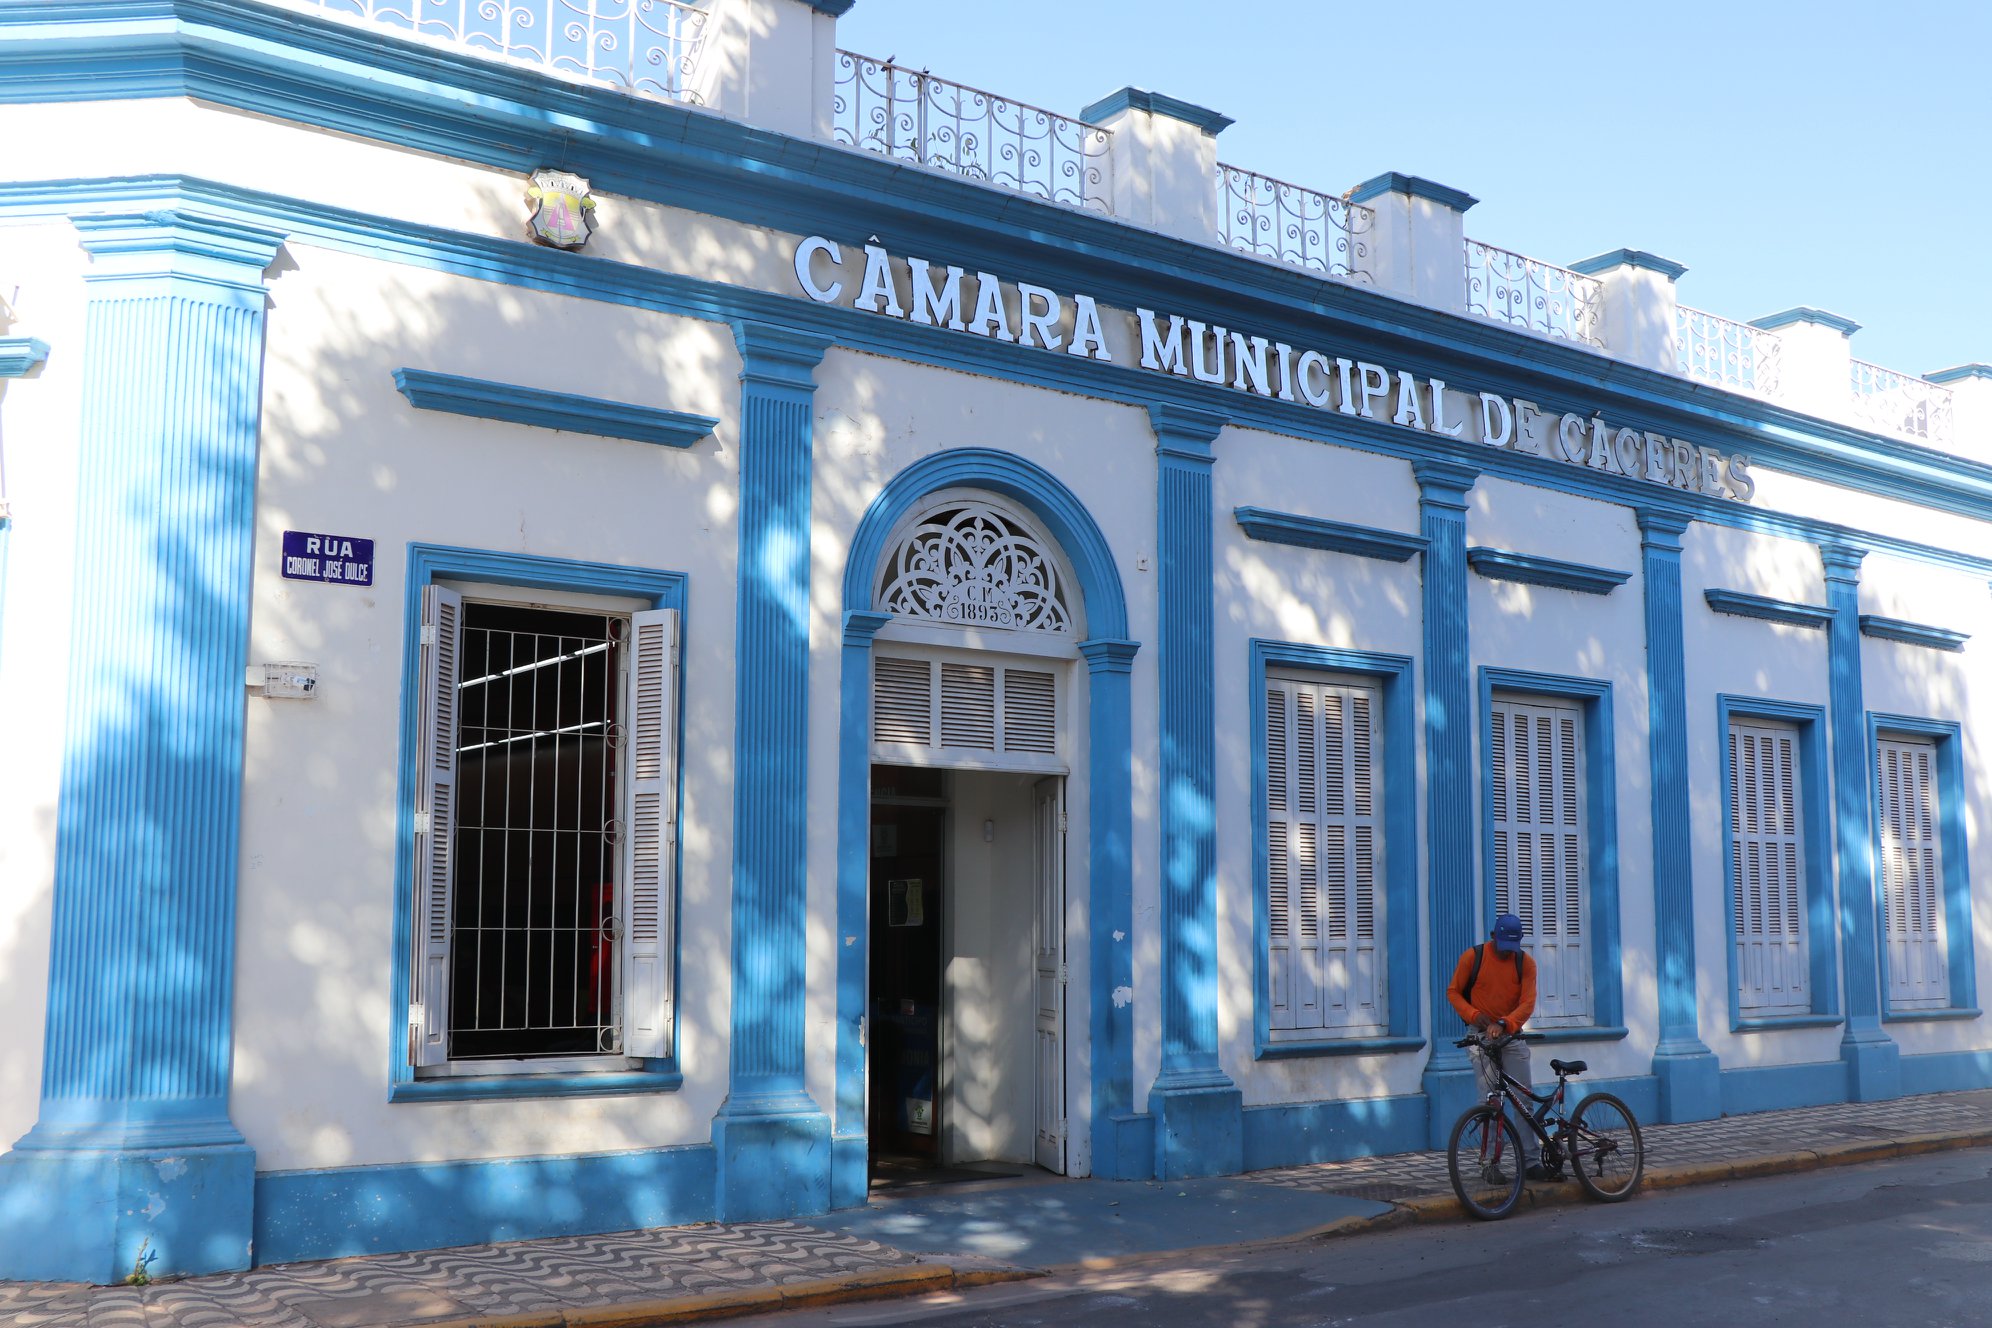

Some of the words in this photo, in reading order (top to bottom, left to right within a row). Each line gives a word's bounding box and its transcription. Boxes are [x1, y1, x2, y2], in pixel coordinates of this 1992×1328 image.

[794, 234, 1112, 363] CÂMARA
[1136, 307, 1463, 437] MUNICIPAL
[1479, 391, 1542, 455] DE
[1558, 410, 1756, 502] CÁCERES
[306, 537, 354, 558] RUA
[286, 556, 320, 577] CORONEL
[323, 558, 343, 579] JOSÉ
[344, 562, 369, 582] DULCE
[960, 602, 999, 622] 1893
